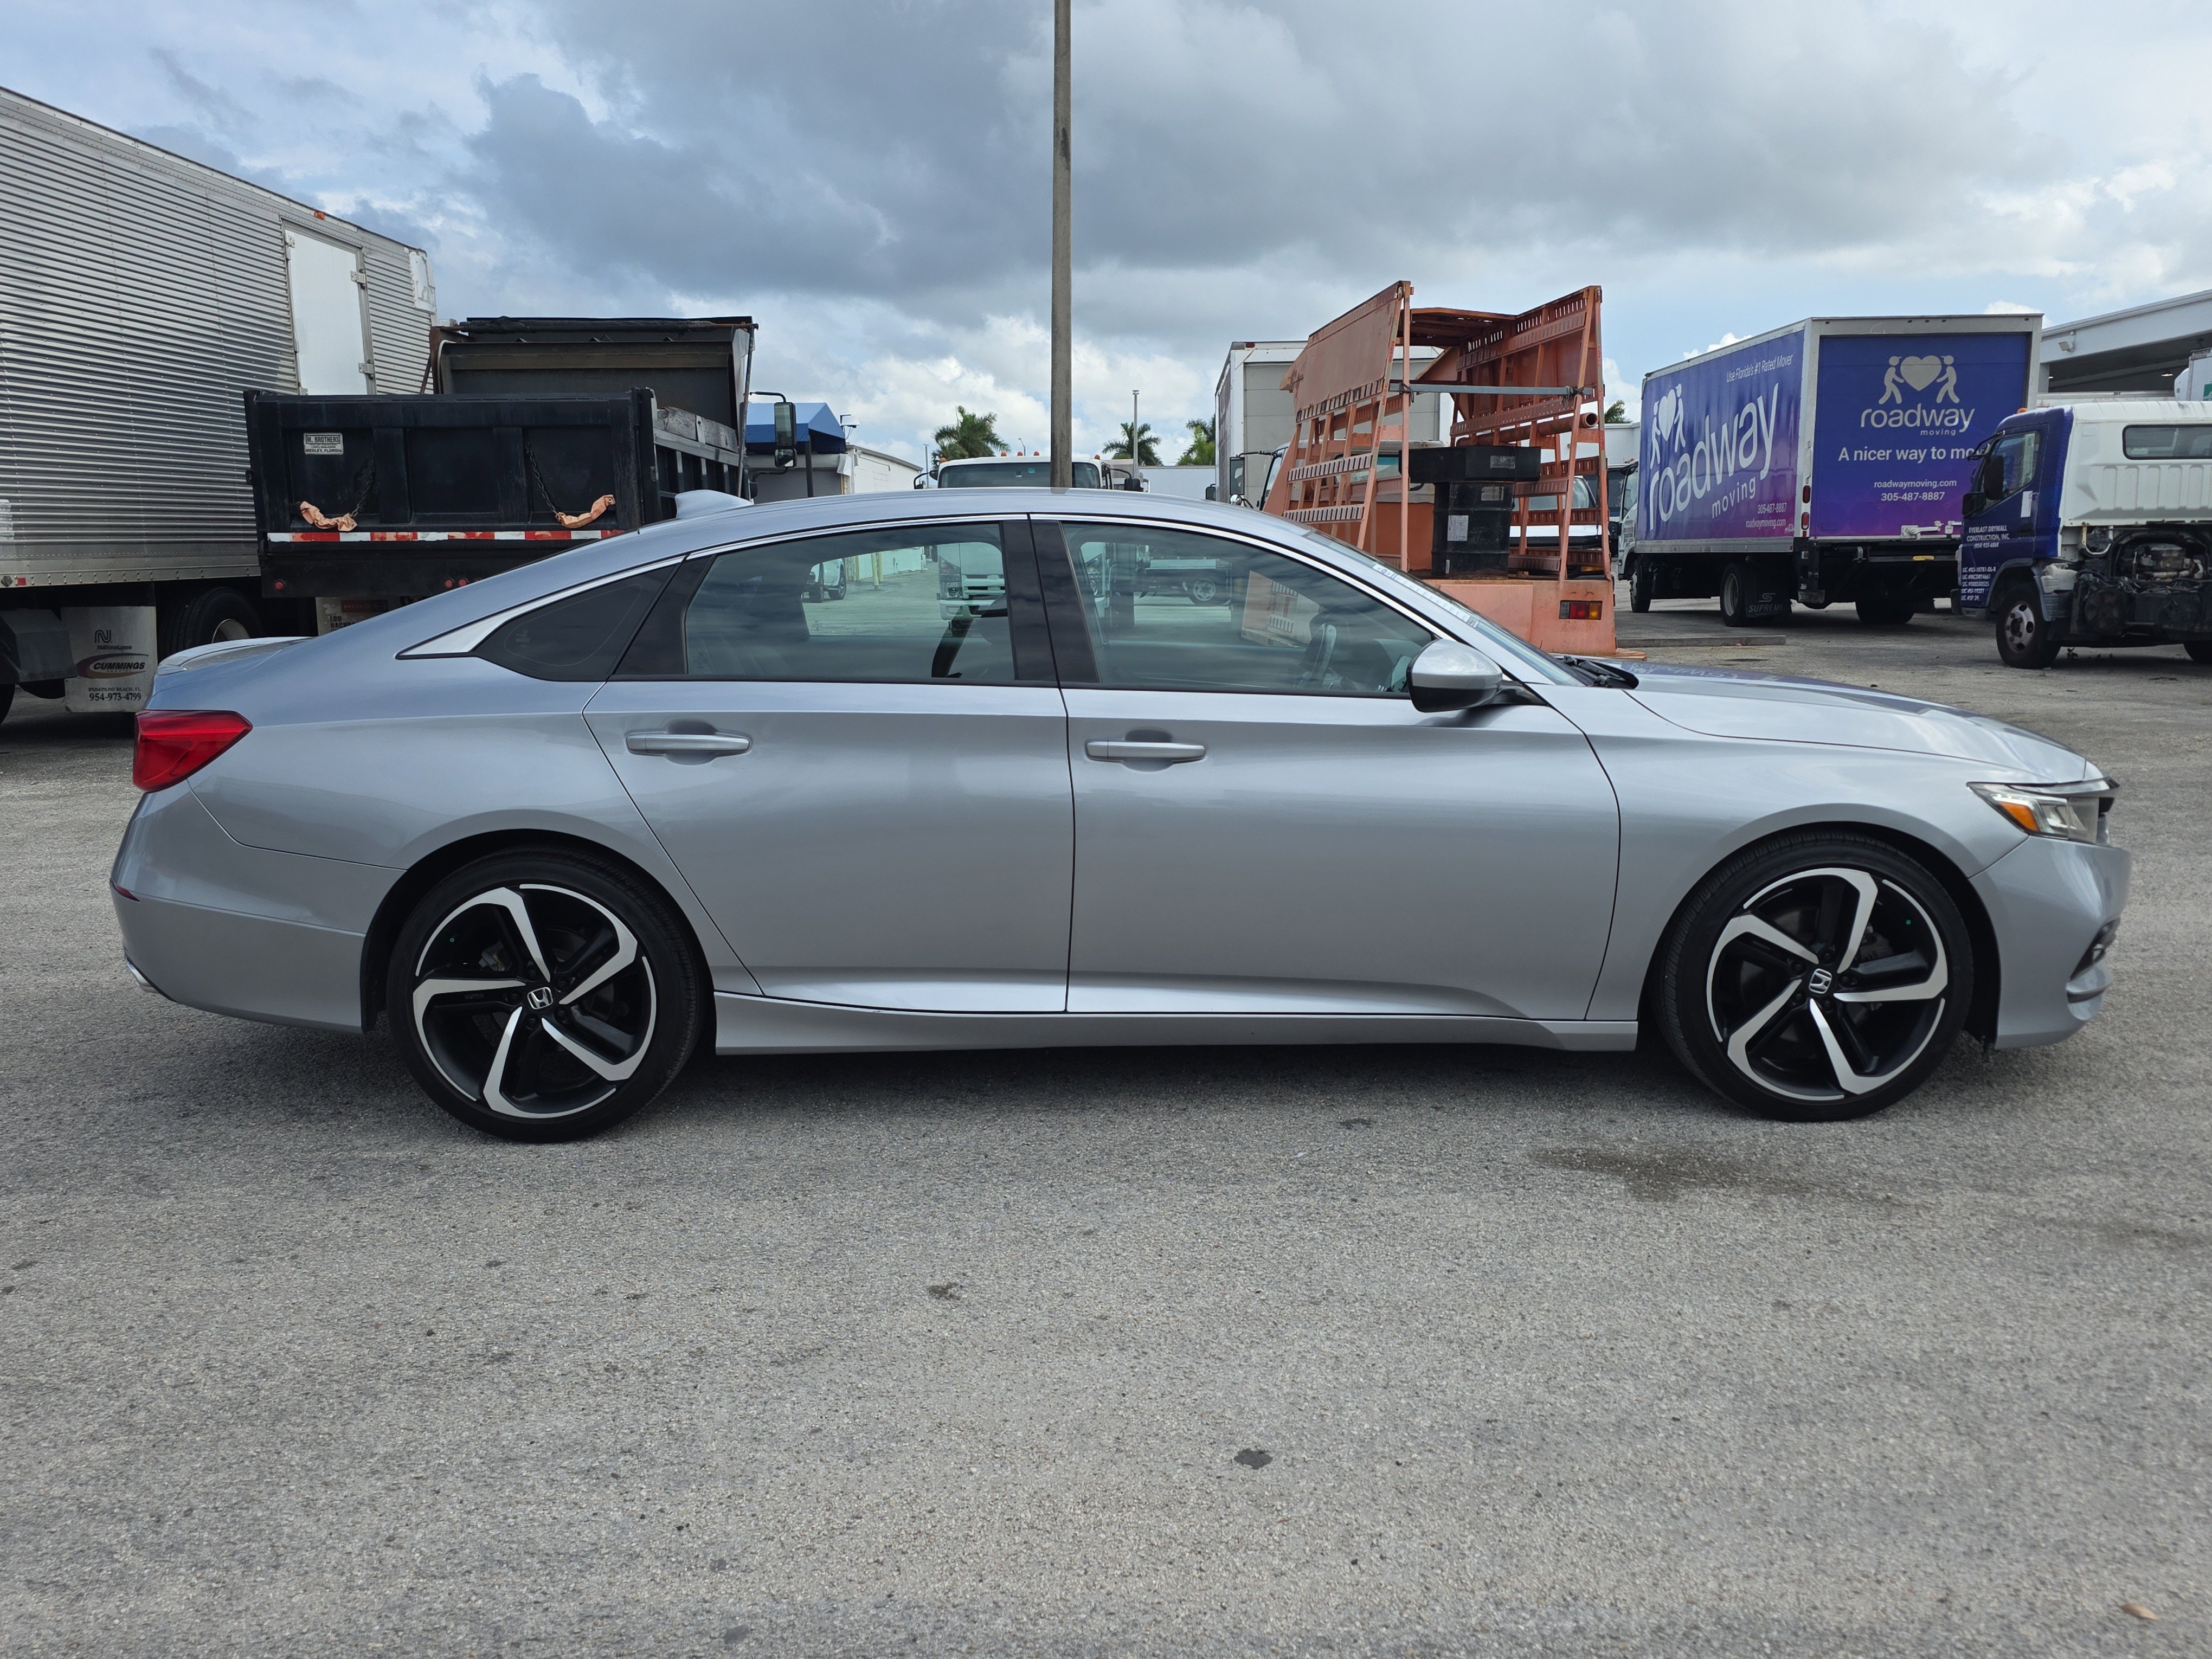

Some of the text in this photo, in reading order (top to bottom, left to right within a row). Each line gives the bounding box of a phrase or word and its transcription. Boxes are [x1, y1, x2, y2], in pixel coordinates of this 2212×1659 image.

[1726, 370, 1735, 383] Use
[1761, 356, 1777, 372] Rated
[1776, 355, 1793, 369] Mover
[1860, 403, 1975, 433] roadway
[1920, 428, 1957, 436] moving
[1649, 382, 1779, 531] roadway
[1838, 447, 1850, 461] A
[1854, 446, 1892, 461] nicer
[1895, 448, 1927, 464] way
[1931, 446, 1946, 460] to
[1874, 479, 1957, 489] roadwaymoving.com
[1712, 477, 1757, 519] moving
[1880, 491, 1945, 501] 305-487-8887
[1748, 604, 1783, 613] SUPREME
[89, 692, 142, 702] 954-973-4799
